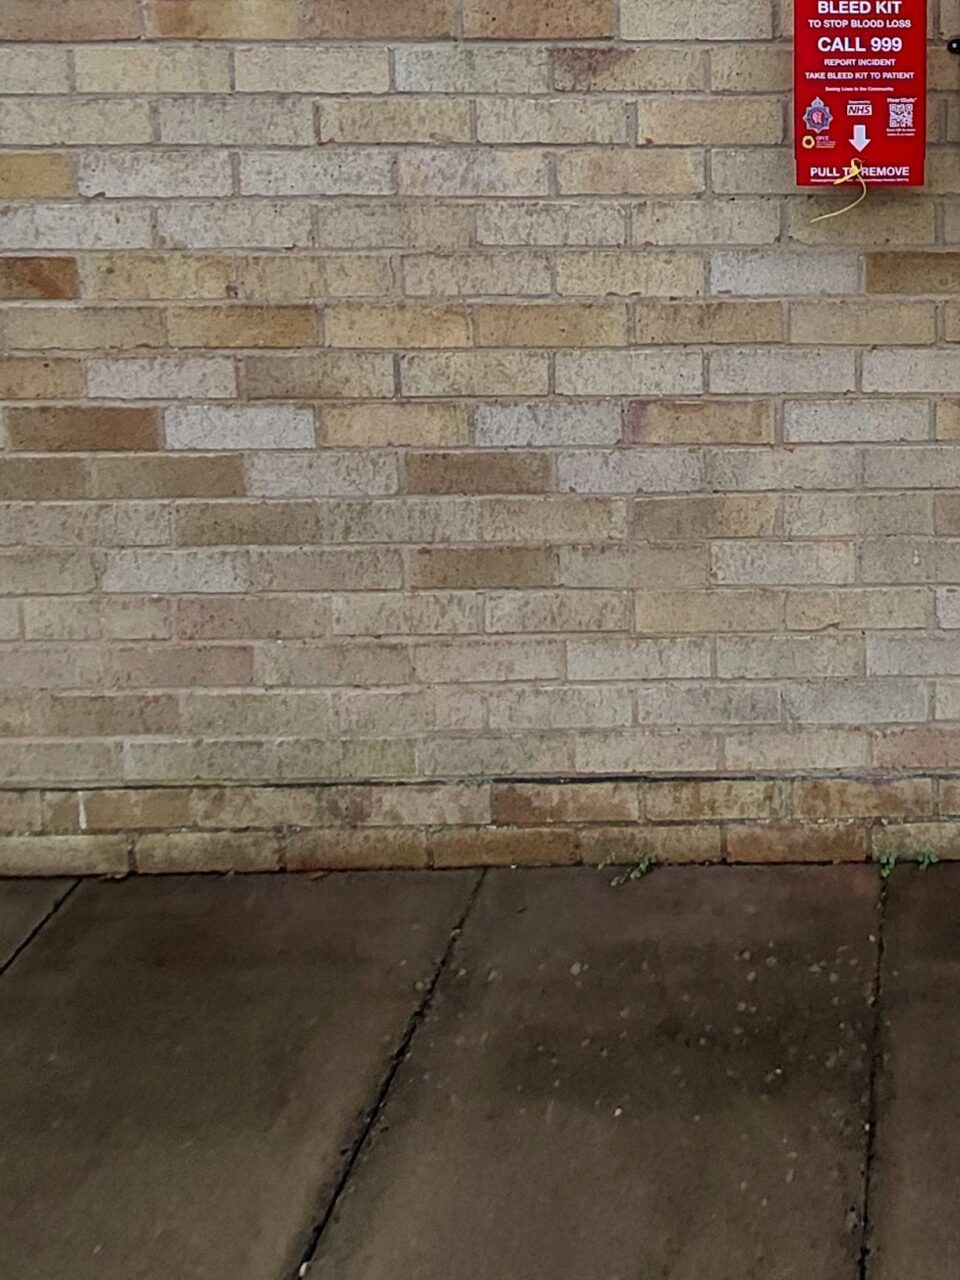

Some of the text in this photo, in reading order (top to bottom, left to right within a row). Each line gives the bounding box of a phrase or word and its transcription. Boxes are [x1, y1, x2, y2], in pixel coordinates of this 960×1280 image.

[818, 0, 902, 14] BLEED KIT
[808, 19, 911, 28] TO STOP BLOOD LOSS
[817, 37, 903, 52] CALL 999
[848, 106, 871, 115] NHS
[810, 166, 840, 176] PULL
[861, 166, 910, 176] REMOVE
